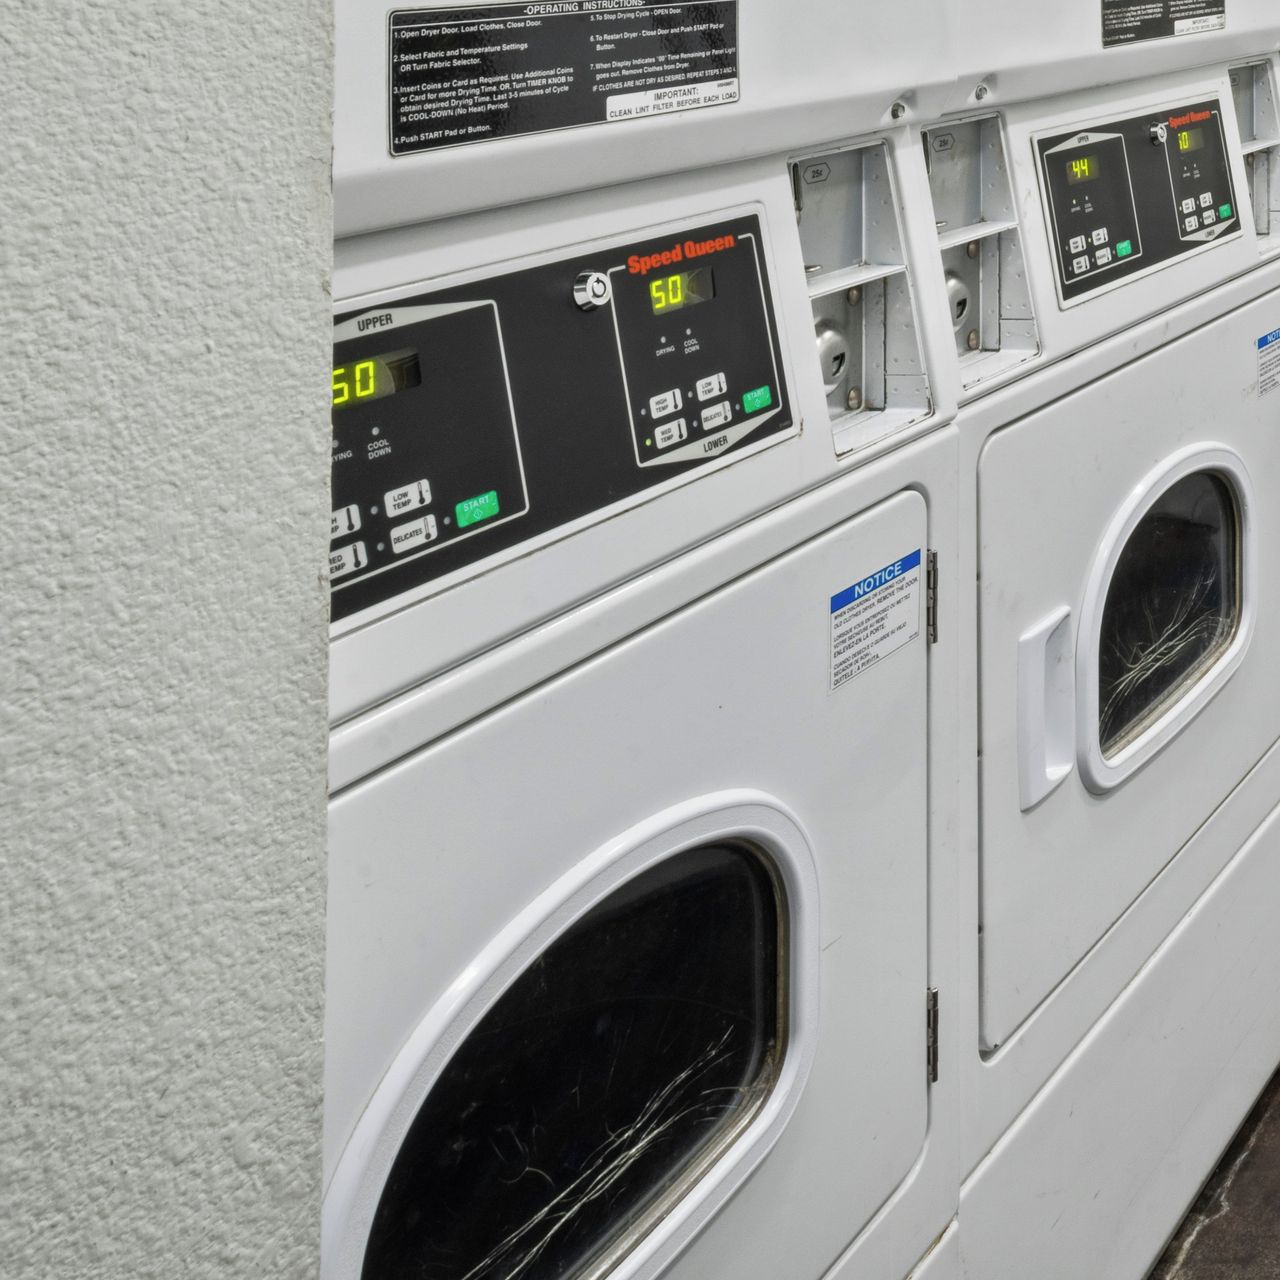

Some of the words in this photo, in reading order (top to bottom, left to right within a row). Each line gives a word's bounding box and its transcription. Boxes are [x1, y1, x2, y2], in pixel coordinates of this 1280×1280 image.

[603, 12, 616, 21] Stop
[617, 11, 635, 19] Drying
[635, 10, 650, 18] Cycle
[653, 8, 669, 16] OPEN
[400, 30, 420, 39] Open
[421, 28, 440, 37] Dryer
[441, 26, 460, 35] Door.
[461, 24, 478, 33] Load
[479, 23, 505, 31] Clothes.
[506, 21, 525, 29] Close
[400, 52, 422, 61] Select
[423, 50, 445, 59] Fabric
[446, 48, 459, 57] and
[460, 45, 501, 55] Temperature
[502, 43, 528, 51] Settings
[400, 64, 412, 73] OR
[413, 63, 428, 71] Turn
[429, 61, 451, 69] Fabric
[452, 58, 482, 67] Selector.
[400, 84, 420, 93] Insert
[421, 83, 442, 91] Coins
[452, 79, 469, 87] Card
[524, 68, 555, 78] Additional
[556, 67, 574, 75] Coins
[409, 94, 426, 102] Card
[457, 87, 480, 96] Drying
[512, 81, 527, 89] Turn
[527, 78, 547, 87] TIMER
[548, 76, 566, 84] KNOB
[654, 87, 699, 101] IMPORTANT:
[400, 104, 422, 113] obtain
[423, 100, 449, 110] desired
[450, 97, 473, 107] Drying
[493, 93, 507, 101] Last
[508, 91, 518, 99] 3-5
[519, 89, 544, 97] minutes
[552, 85, 569, 93] Cycle
[609, 107, 632, 118] CLEAN
[635, 105, 650, 115] LINT
[653, 102, 674, 112] FILTER
[676, 97, 701, 108] BEFORE
[703, 94, 719, 104] EACH
[722, 91, 737, 100] LOAD
[400, 115, 407, 123] is
[408, 108, 454, 121] COOL-DOWN
[454, 107, 467, 116] (No
[468, 104, 486, 113] Heat)
[487, 102, 510, 111] Period.
[400, 135, 419, 143] Push
[420, 130, 443, 141] START
[444, 128, 458, 137] Pad
[468, 124, 492, 133] Button.
[1072, 158, 1089, 179] 44
[627, 243, 683, 275] Speed
[684, 233, 736, 260] Queen
[651, 274, 683, 309] 50
[357, 312, 393, 332] UPPER
[655, 345, 676, 357] DRYING
[683, 338, 699, 348] COOL
[684, 344, 700, 355] DOWN
[332, 360, 375, 405] 50
[702, 387, 714, 397] TEMP
[656, 403, 669, 414] TEMP
[367, 438, 390, 451] COOL
[661, 434, 674, 443] TEMP
[703, 435, 729, 453] LOWER
[368, 446, 392, 460] DOWN
[393, 491, 409, 503] LOW
[393, 498, 412, 511] TEMP
[463, 495, 490, 512] START
[393, 528, 424, 545] DELICATES
[854, 561, 902, 599] NOTICE
